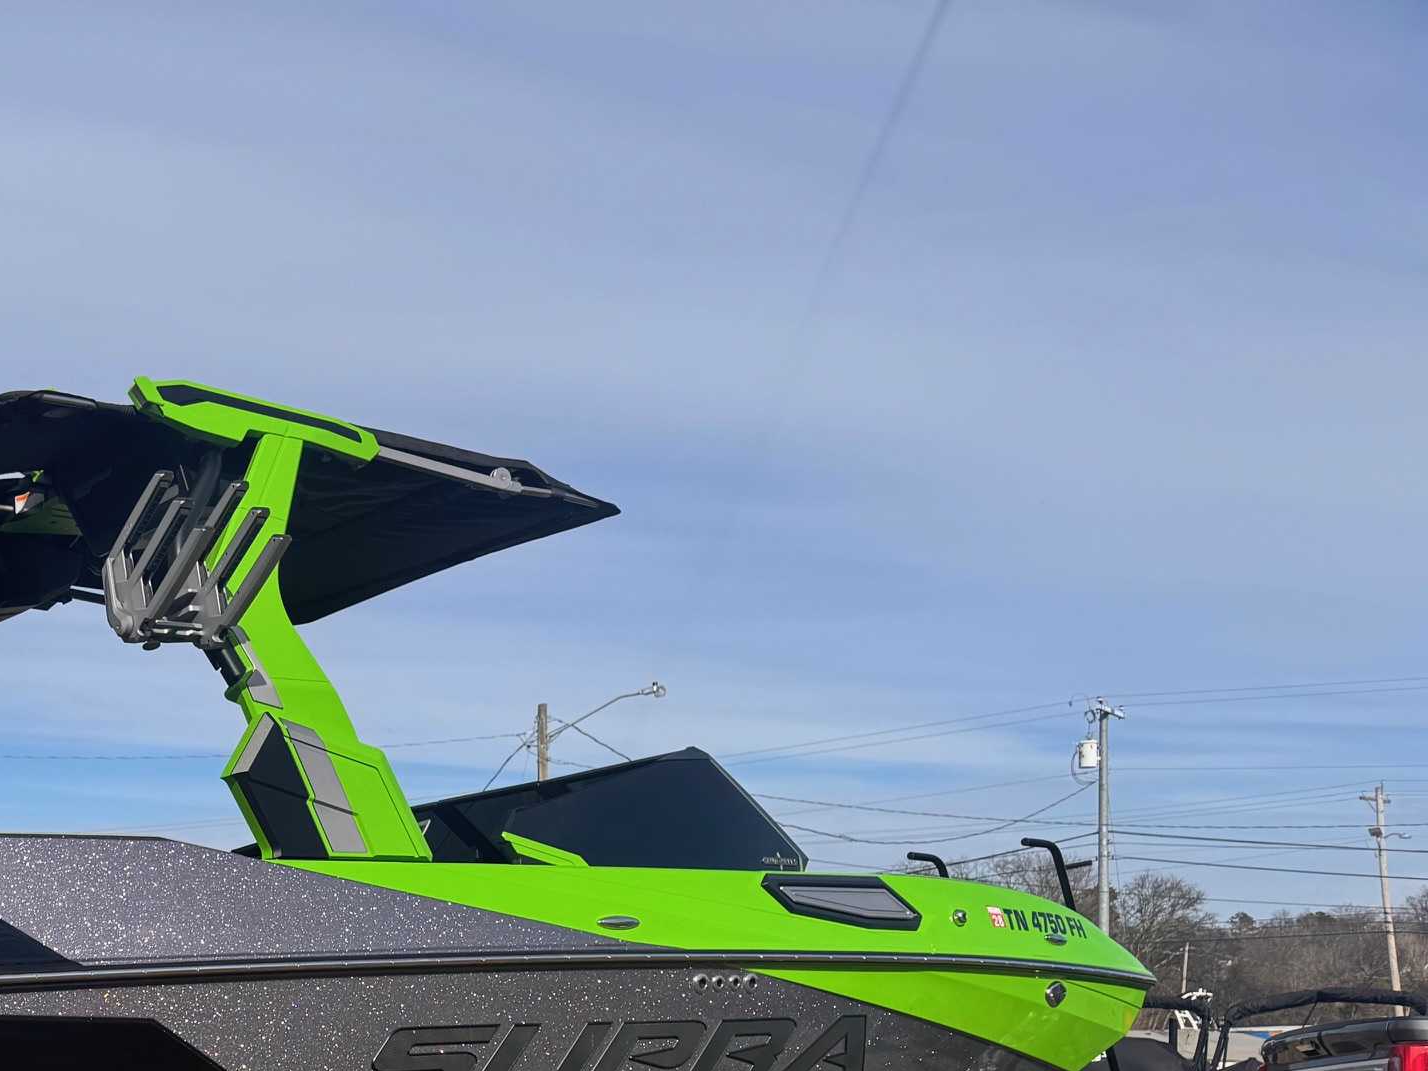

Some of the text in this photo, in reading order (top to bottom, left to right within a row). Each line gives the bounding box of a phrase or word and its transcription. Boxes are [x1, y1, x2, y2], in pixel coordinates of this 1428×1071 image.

[1003, 908, 1087, 938] TN 4750 FH
